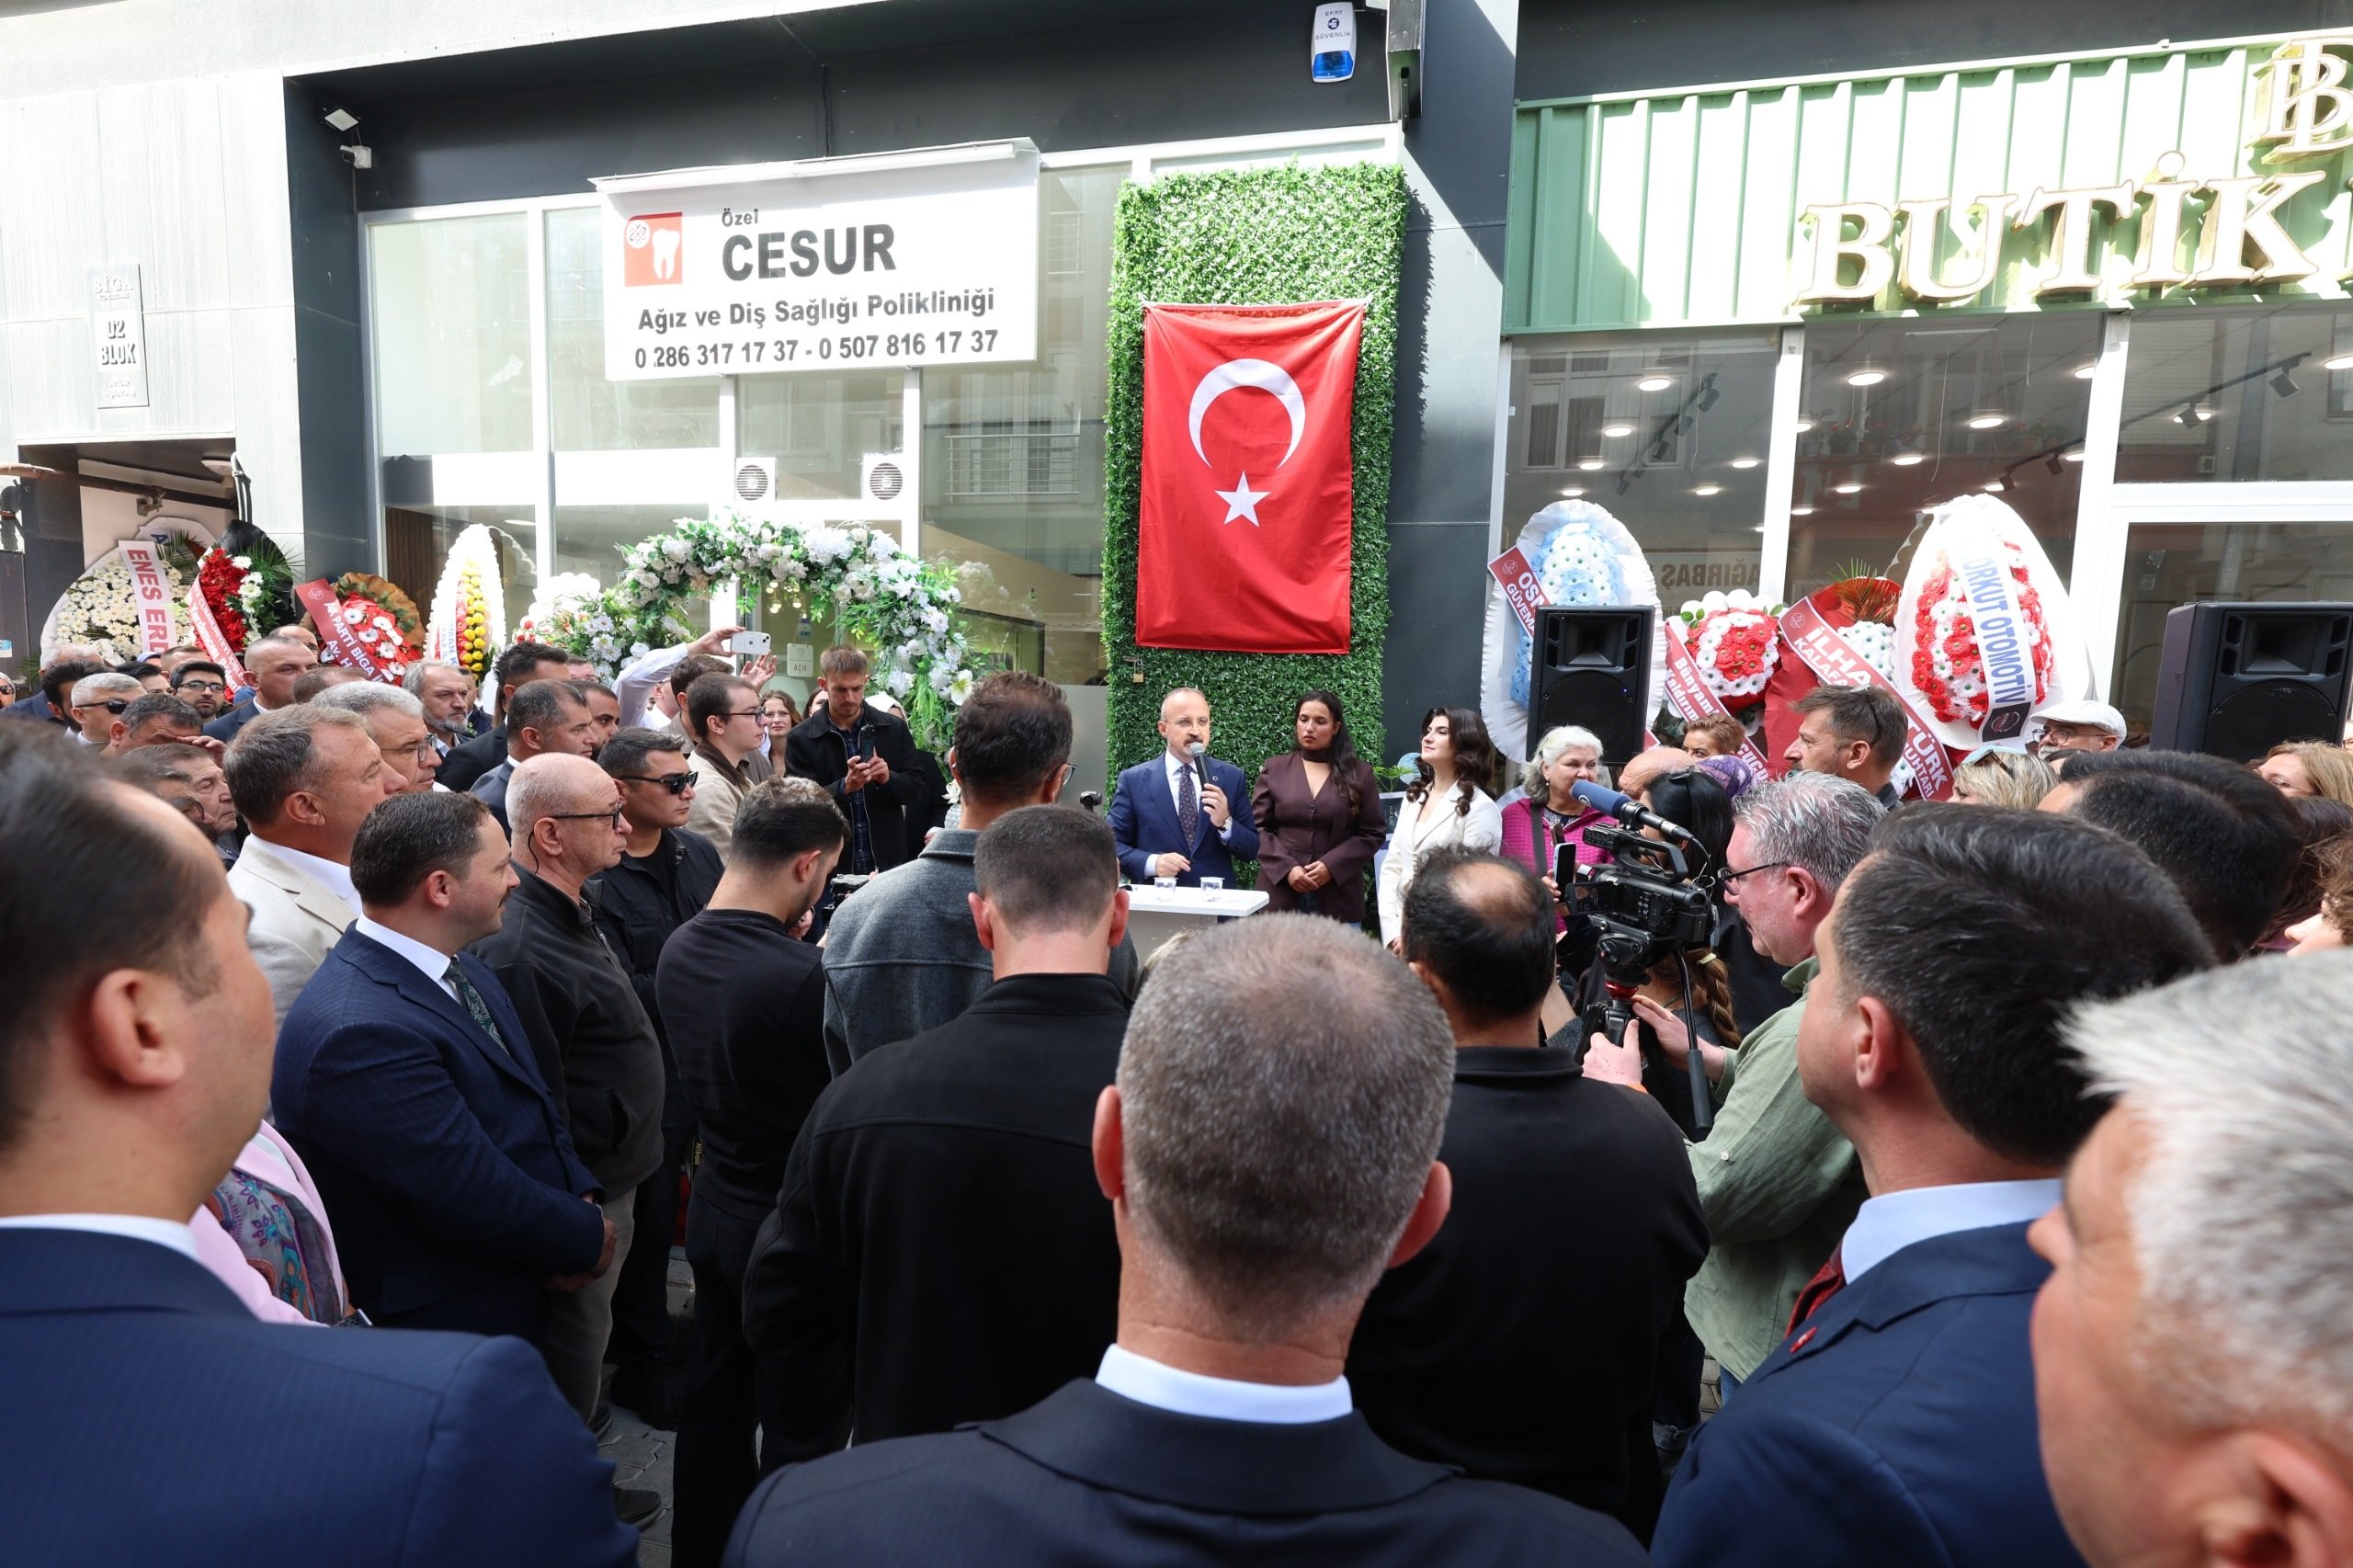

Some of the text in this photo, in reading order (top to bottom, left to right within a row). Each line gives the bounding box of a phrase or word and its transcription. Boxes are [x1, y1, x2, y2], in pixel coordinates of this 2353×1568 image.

[722, 208, 759, 227] Özel
[1796, 150, 2326, 302] BUTİK
[722, 223, 897, 281] CESUR
[638, 287, 995, 335] Ağız ve Diş Sağlığı Polikliniği
[100, 343, 137, 366] BLOK
[634, 347, 647, 369] 0
[654, 345, 690, 368] 286
[697, 342, 733, 366] 317
[741, 341, 767, 363] 17
[773, 339, 799, 362] 37
[819, 337, 832, 359] 0
[839, 335, 880, 359] 507
[886, 332, 926, 357] 816
[935, 330, 962, 354] 17
[970, 329, 999, 353] 37
[127, 549, 163, 601] ENES
[324, 599, 339, 618] AK
[331, 616, 358, 647] PARTİ
[340, 657, 354, 669] H
[350, 645, 376, 677] BİGA
[793, 664, 808, 675] AÇIK
[1804, 627, 1874, 689] İLHA
[1980, 617, 2032, 703] OTOMOTİV
[1904, 744, 1936, 799] UHTARI
